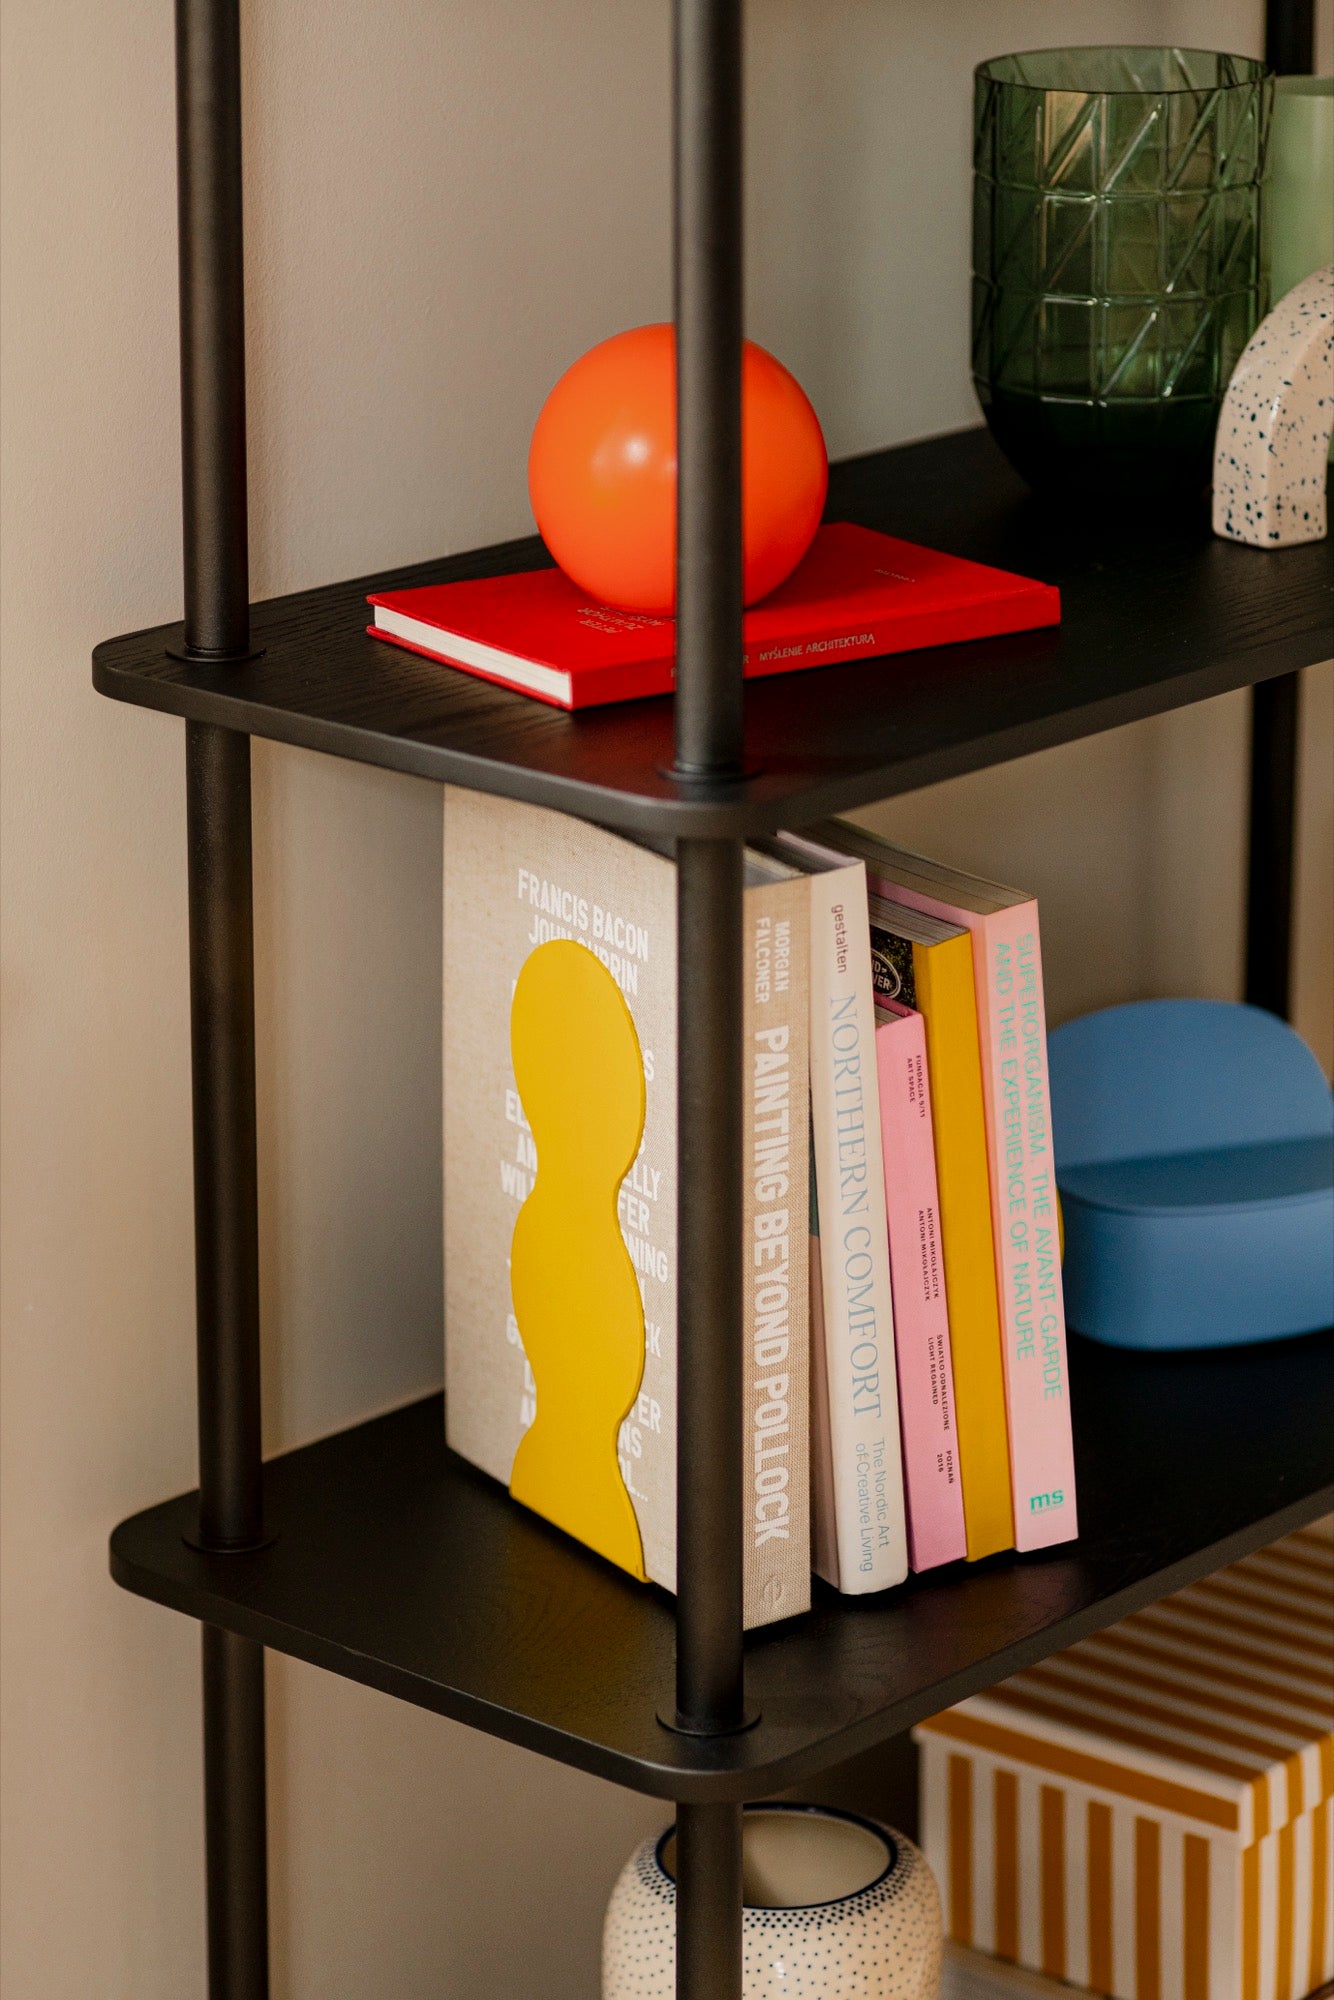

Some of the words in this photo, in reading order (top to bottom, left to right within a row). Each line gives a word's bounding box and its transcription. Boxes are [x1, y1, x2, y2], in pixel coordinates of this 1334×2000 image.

[759, 645, 803, 662] MYŚLENIE
[806, 633, 875, 653] ARCHITEKTURĄ
[518, 868, 588, 931] FRANCIS
[592, 905, 648, 962] BACON
[831, 904, 848, 973] gestalten
[755, 916, 770, 1005] FALCONER
[774, 920, 790, 993] MORGAN
[995, 943, 1013, 996] AND
[998, 1000, 1017, 1051] THE
[754, 1024, 789, 1203] PAINTING
[830, 992, 869, 1216] NORTHERN
[1001, 1058, 1027, 1216] EXPERIENCE
[1031, 1167, 1051, 1219] THE
[918, 1209, 926, 1241] ANTONI
[927, 1207, 935, 1239] ANTONI
[1009, 1221, 1029, 1254] OF
[754, 1208, 789, 1368] BEYOND
[921, 1243, 931, 1301] MIKOŁAJCZYK
[929, 1240, 939, 1298] MIKOŁAJCZYK
[843, 1226, 882, 1418] COMFORT
[1012, 1261, 1035, 1360] NATURE
[1035, 1226, 1062, 1400] AVANT-GARDE
[930, 1364, 938, 1405] REGAINED
[939, 1372, 950, 1431] ODNALEZIONE
[754, 1373, 789, 1548] POLLOCK
[855, 1443, 869, 1461] of
[873, 1437, 885, 1468] The
[856, 1461, 872, 1524] Creative
[875, 1471, 888, 1520] Nordic
[1030, 1489, 1063, 1511] ms
[859, 1527, 874, 1572] Living
[878, 1525, 890, 1548] Art
